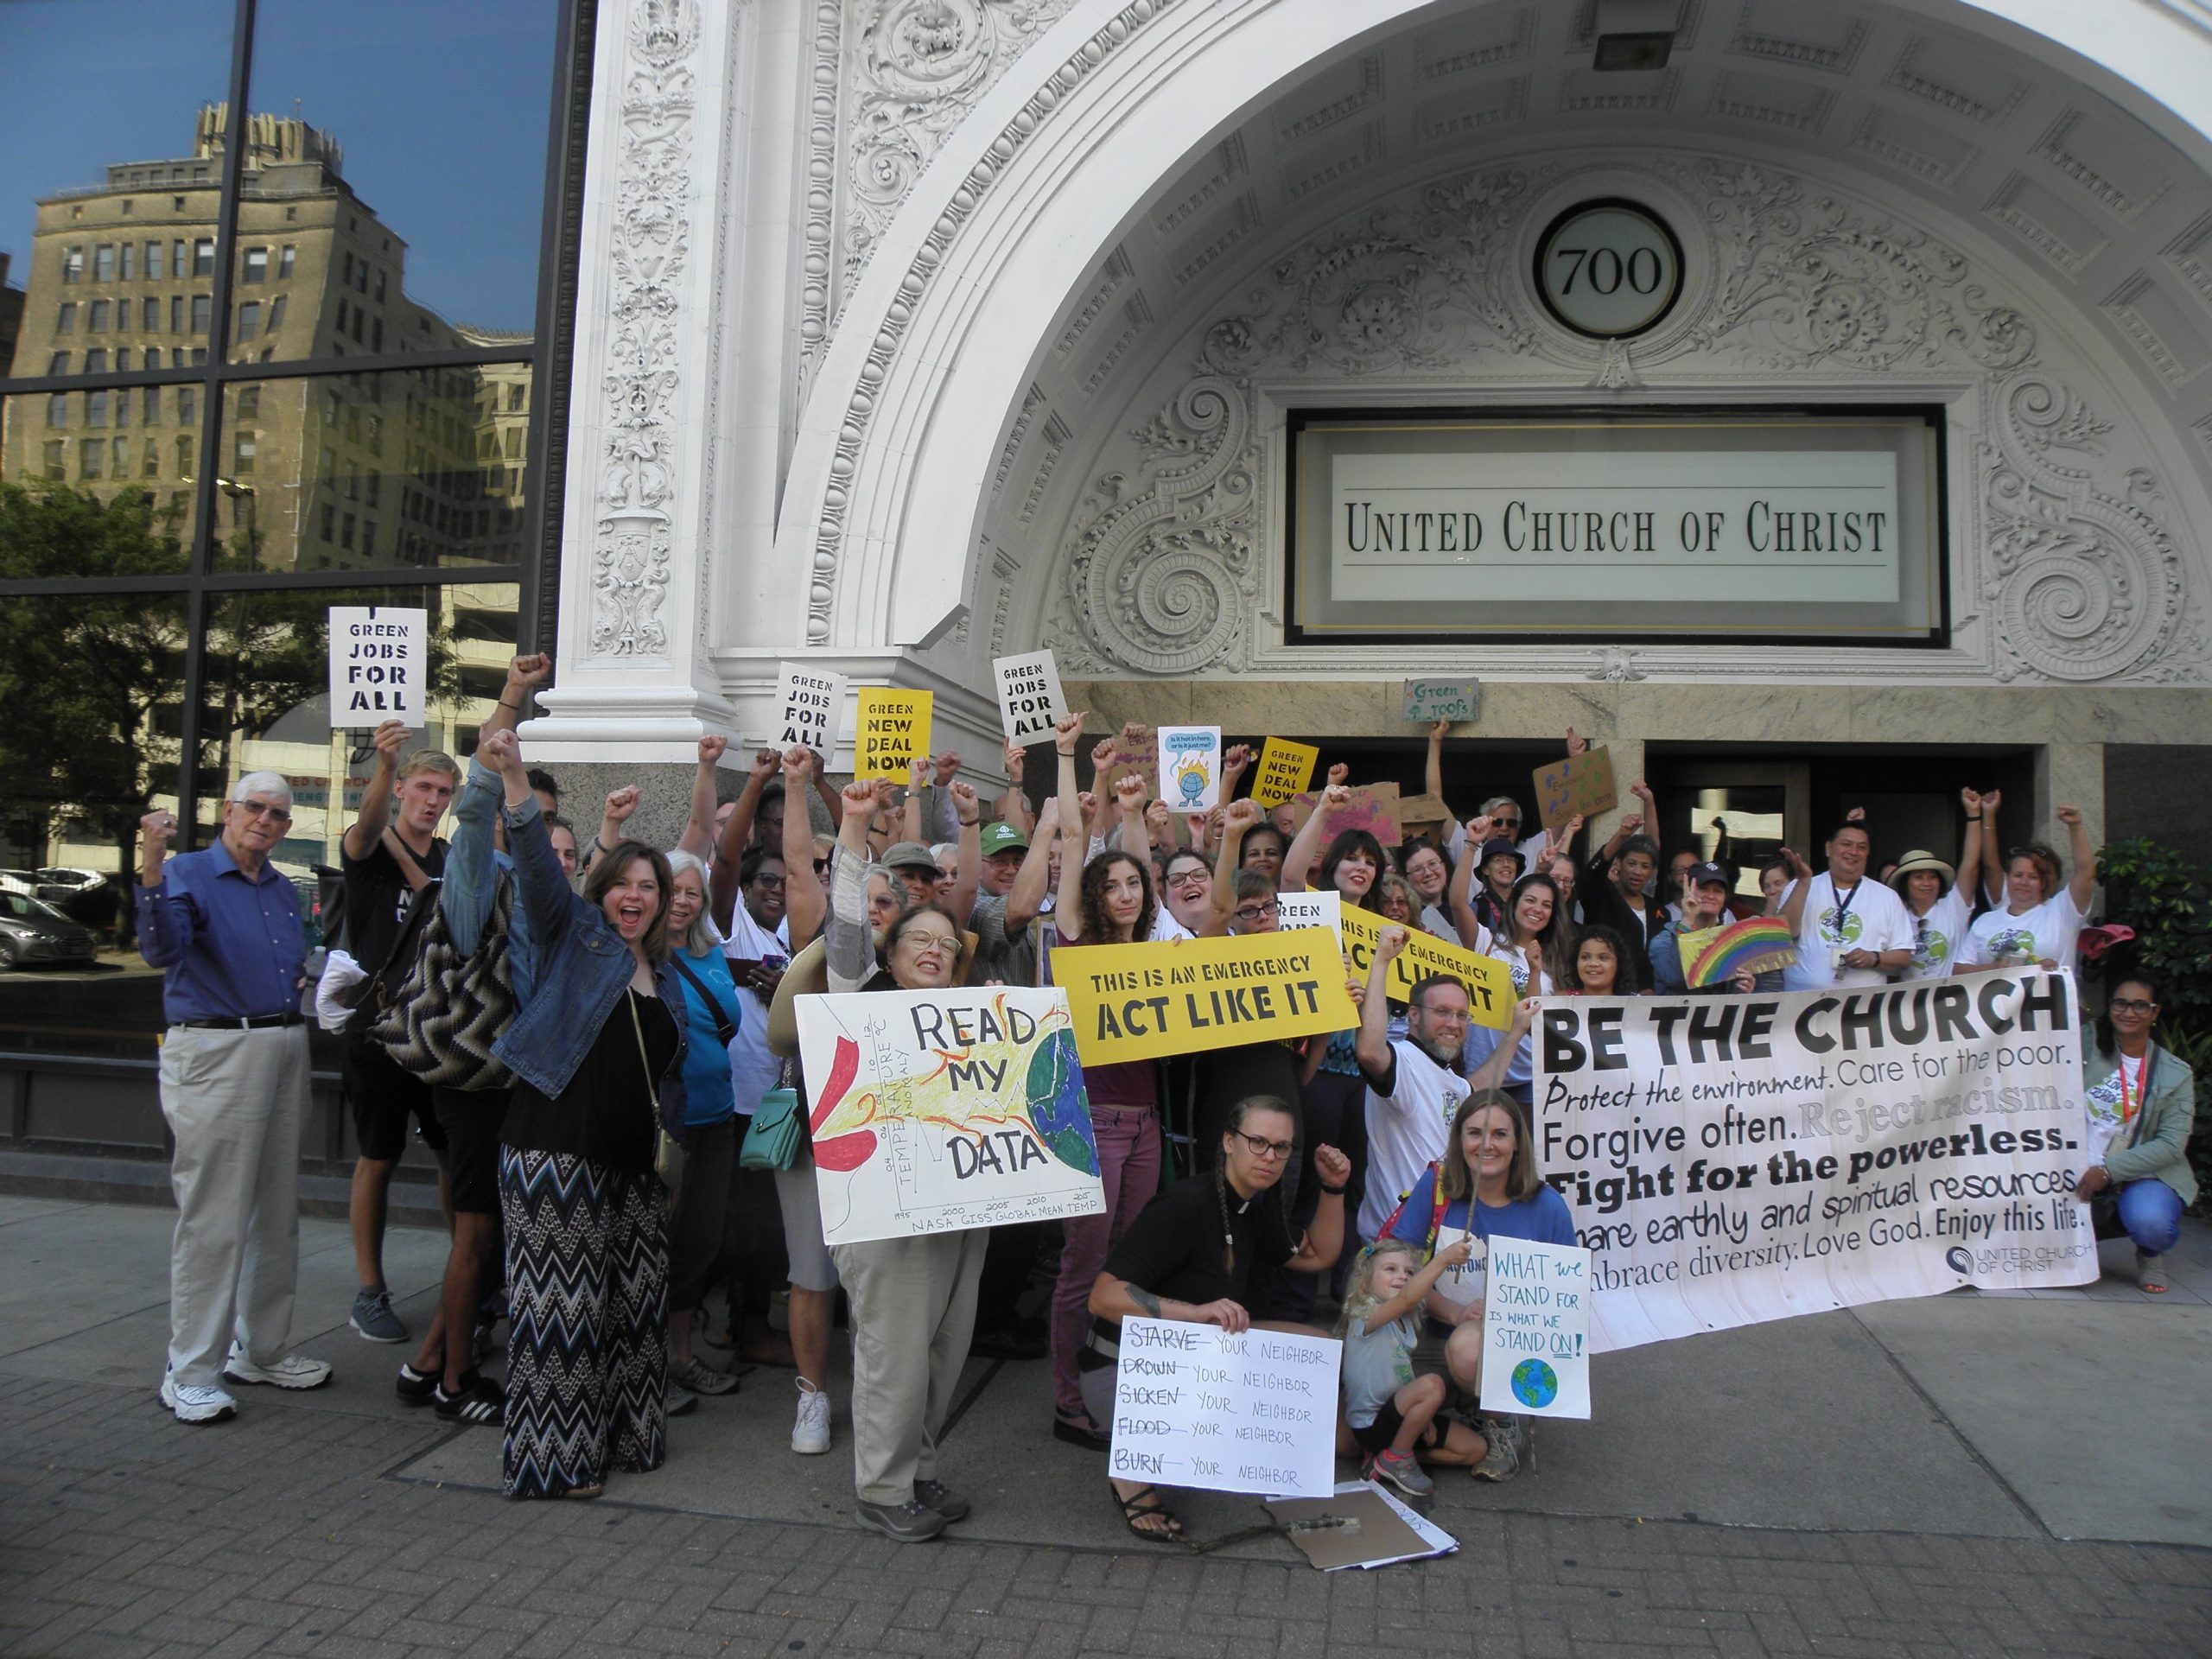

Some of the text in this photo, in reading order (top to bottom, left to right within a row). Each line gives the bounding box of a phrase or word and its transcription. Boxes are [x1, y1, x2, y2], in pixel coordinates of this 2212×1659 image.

[1557, 246, 1662, 295] 700
[349, 624, 409, 638] GREEN
[349, 644, 408, 658] JOBS
[348, 665, 406, 684] FOR
[791, 675, 833, 691] GREEN
[1003, 664, 1044, 679] GREEN
[1007, 678, 1046, 696] JOBS
[349, 691, 406, 711] ALL
[788, 690, 830, 709] JOBS
[868, 703, 913, 715] GREEN
[1009, 696, 1052, 716] FOR
[785, 707, 827, 728] FOR
[868, 719, 912, 733] NEW
[1014, 714, 1056, 737] ALL
[780, 727, 823, 748] ALL
[866, 737, 912, 753] DEAL
[868, 756, 912, 771] NOW
[1268, 761, 1300, 775] NEW
[1271, 750, 1304, 763] GREEN
[1264, 774, 1297, 789] DEAL
[1262, 787, 1294, 801] NOW
[1279, 906, 1320, 917] REEN
[1341, 918, 1364, 938] HIS
[1409, 943, 1488, 982] EMERGENCY
[1090, 955, 1311, 994] THIS IS AN EMERGENCY
[1467, 982, 1492, 1011] IT
[1097, 980, 1319, 1040] ACT LIKE IT
[910, 1003, 1036, 1051] READ
[1542, 974, 2069, 1074] BE THE CHURCH
[894, 1050, 914, 1116] ANOMALY
[948, 1058, 1007, 1092] MY
[1542, 1044, 2072, 1116] Protect the environment. Care for the poor.
[878, 1042, 912, 1185] TEMPERATURE
[1543, 1117, 1685, 1168] Forgive
[1700, 1103, 1796, 1148] often.
[1798, 1094, 1926, 1143] Reject
[1930, 1076, 2075, 1122] racism.
[947, 1129, 1048, 1179] DATA
[1545, 1123, 2078, 1214] Fight for the powerless.
[912, 1200, 1097, 1232] NASA GISS GLOBAL MEAN TEMP
[942, 1207, 965, 1217] 2000
[986, 1201, 1010, 1211] 2005
[1027, 1196, 1046, 1205] 2010
[1073, 1192, 1090, 1201] 2015
[1647, 1200, 1748, 1245] earthly
[1761, 1190, 1814, 1231] and
[1822, 1173, 1919, 1227] spiritual
[1591, 1198, 2085, 1294] brace diversity. Love God. Enjoy this life.
[1976, 1242, 2093, 1262] UNITED CHURCH
[1494, 1253, 1583, 1281] WHAT we
[1978, 1259, 2054, 1274] OF CHRIST
[1497, 1283, 1580, 1310] STAND FOR
[1489, 1311, 1561, 1328] IS WHAT WE
[1128, 1322, 1329, 1365] STARVE YOUR NEIGHBOR
[1496, 1328, 1546, 1352] STAND
[1122, 1358, 1313, 1397] DROWN YOUR NEIGHBOR
[1119, 1383, 1313, 1424] SICKEN YOUR NEIGHBOR
[1117, 1417, 1294, 1446] FLOOD YOUR NEIGHBOR
[1115, 1449, 1302, 1488] BURN YOUR NEIGHBOR
